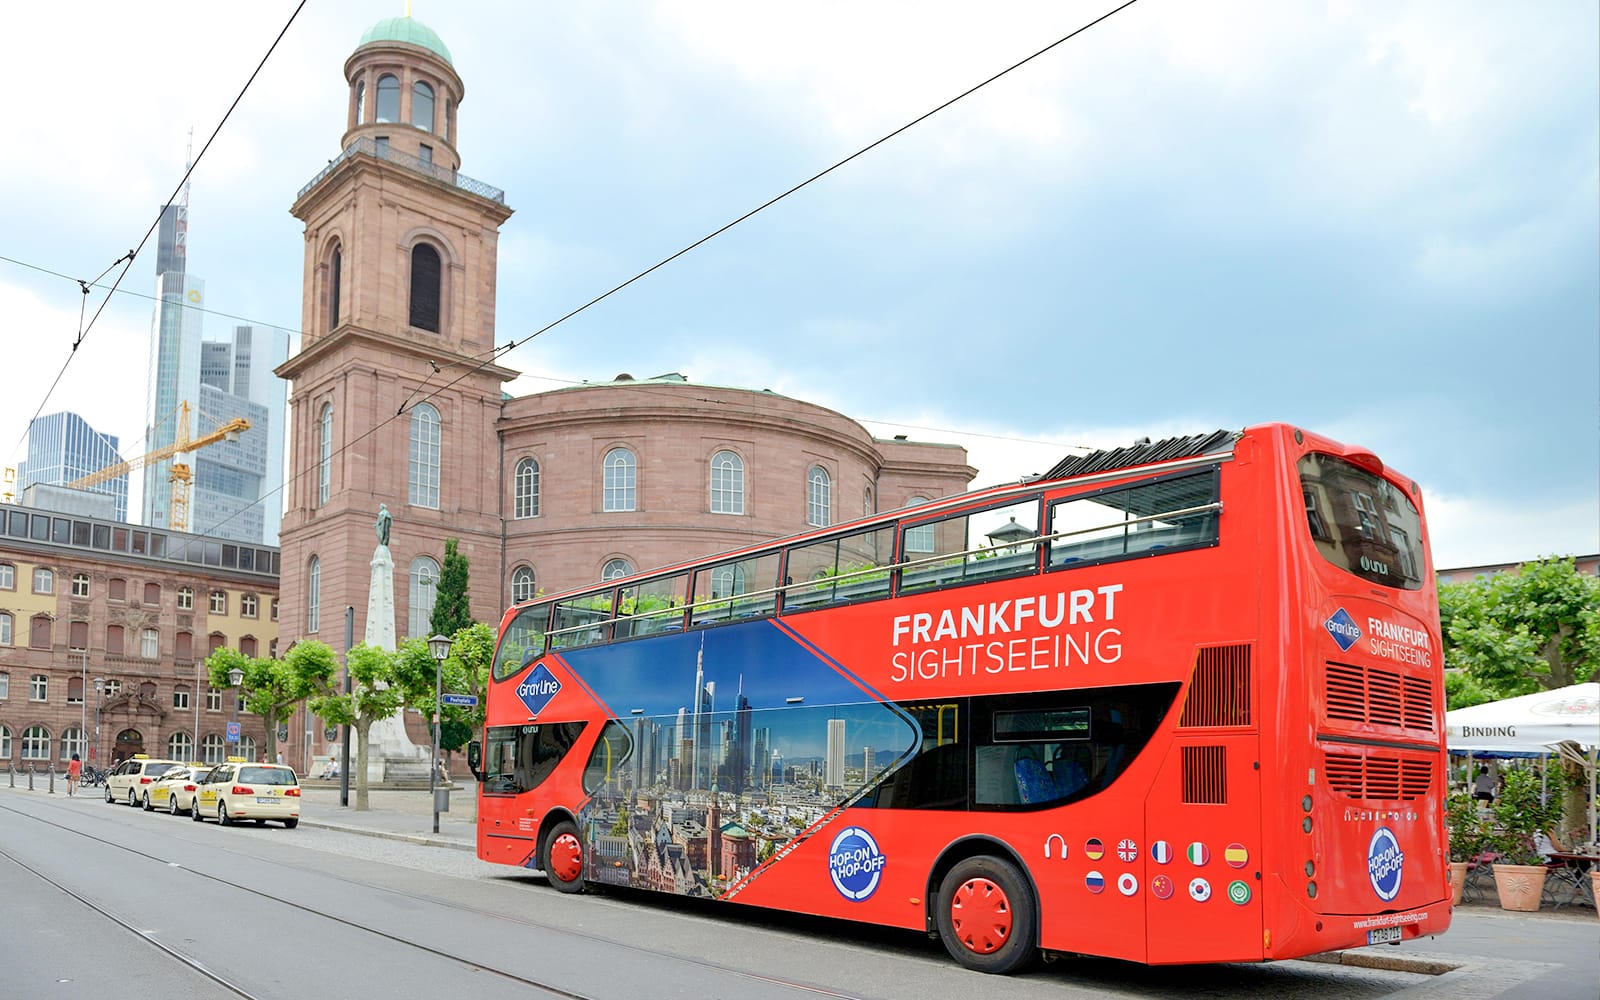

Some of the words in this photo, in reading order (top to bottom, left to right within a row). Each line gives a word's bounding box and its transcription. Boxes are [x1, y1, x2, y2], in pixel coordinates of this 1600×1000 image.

[892, 583, 1124, 647] FRANKFURT
[1368, 617, 1429, 649] FRANKFURT
[891, 628, 1122, 682] SIGHTSEEING
[1370, 638, 1431, 668] SIGHTSEEING
[1462, 725, 1516, 738] BINDING
[829, 846, 870, 869] HOP-ON
[838, 855, 885, 879] HOP-OFF
[1368, 846, 1395, 873] HOP-ON
[1375, 853, 1404, 882] HOP-OFF
